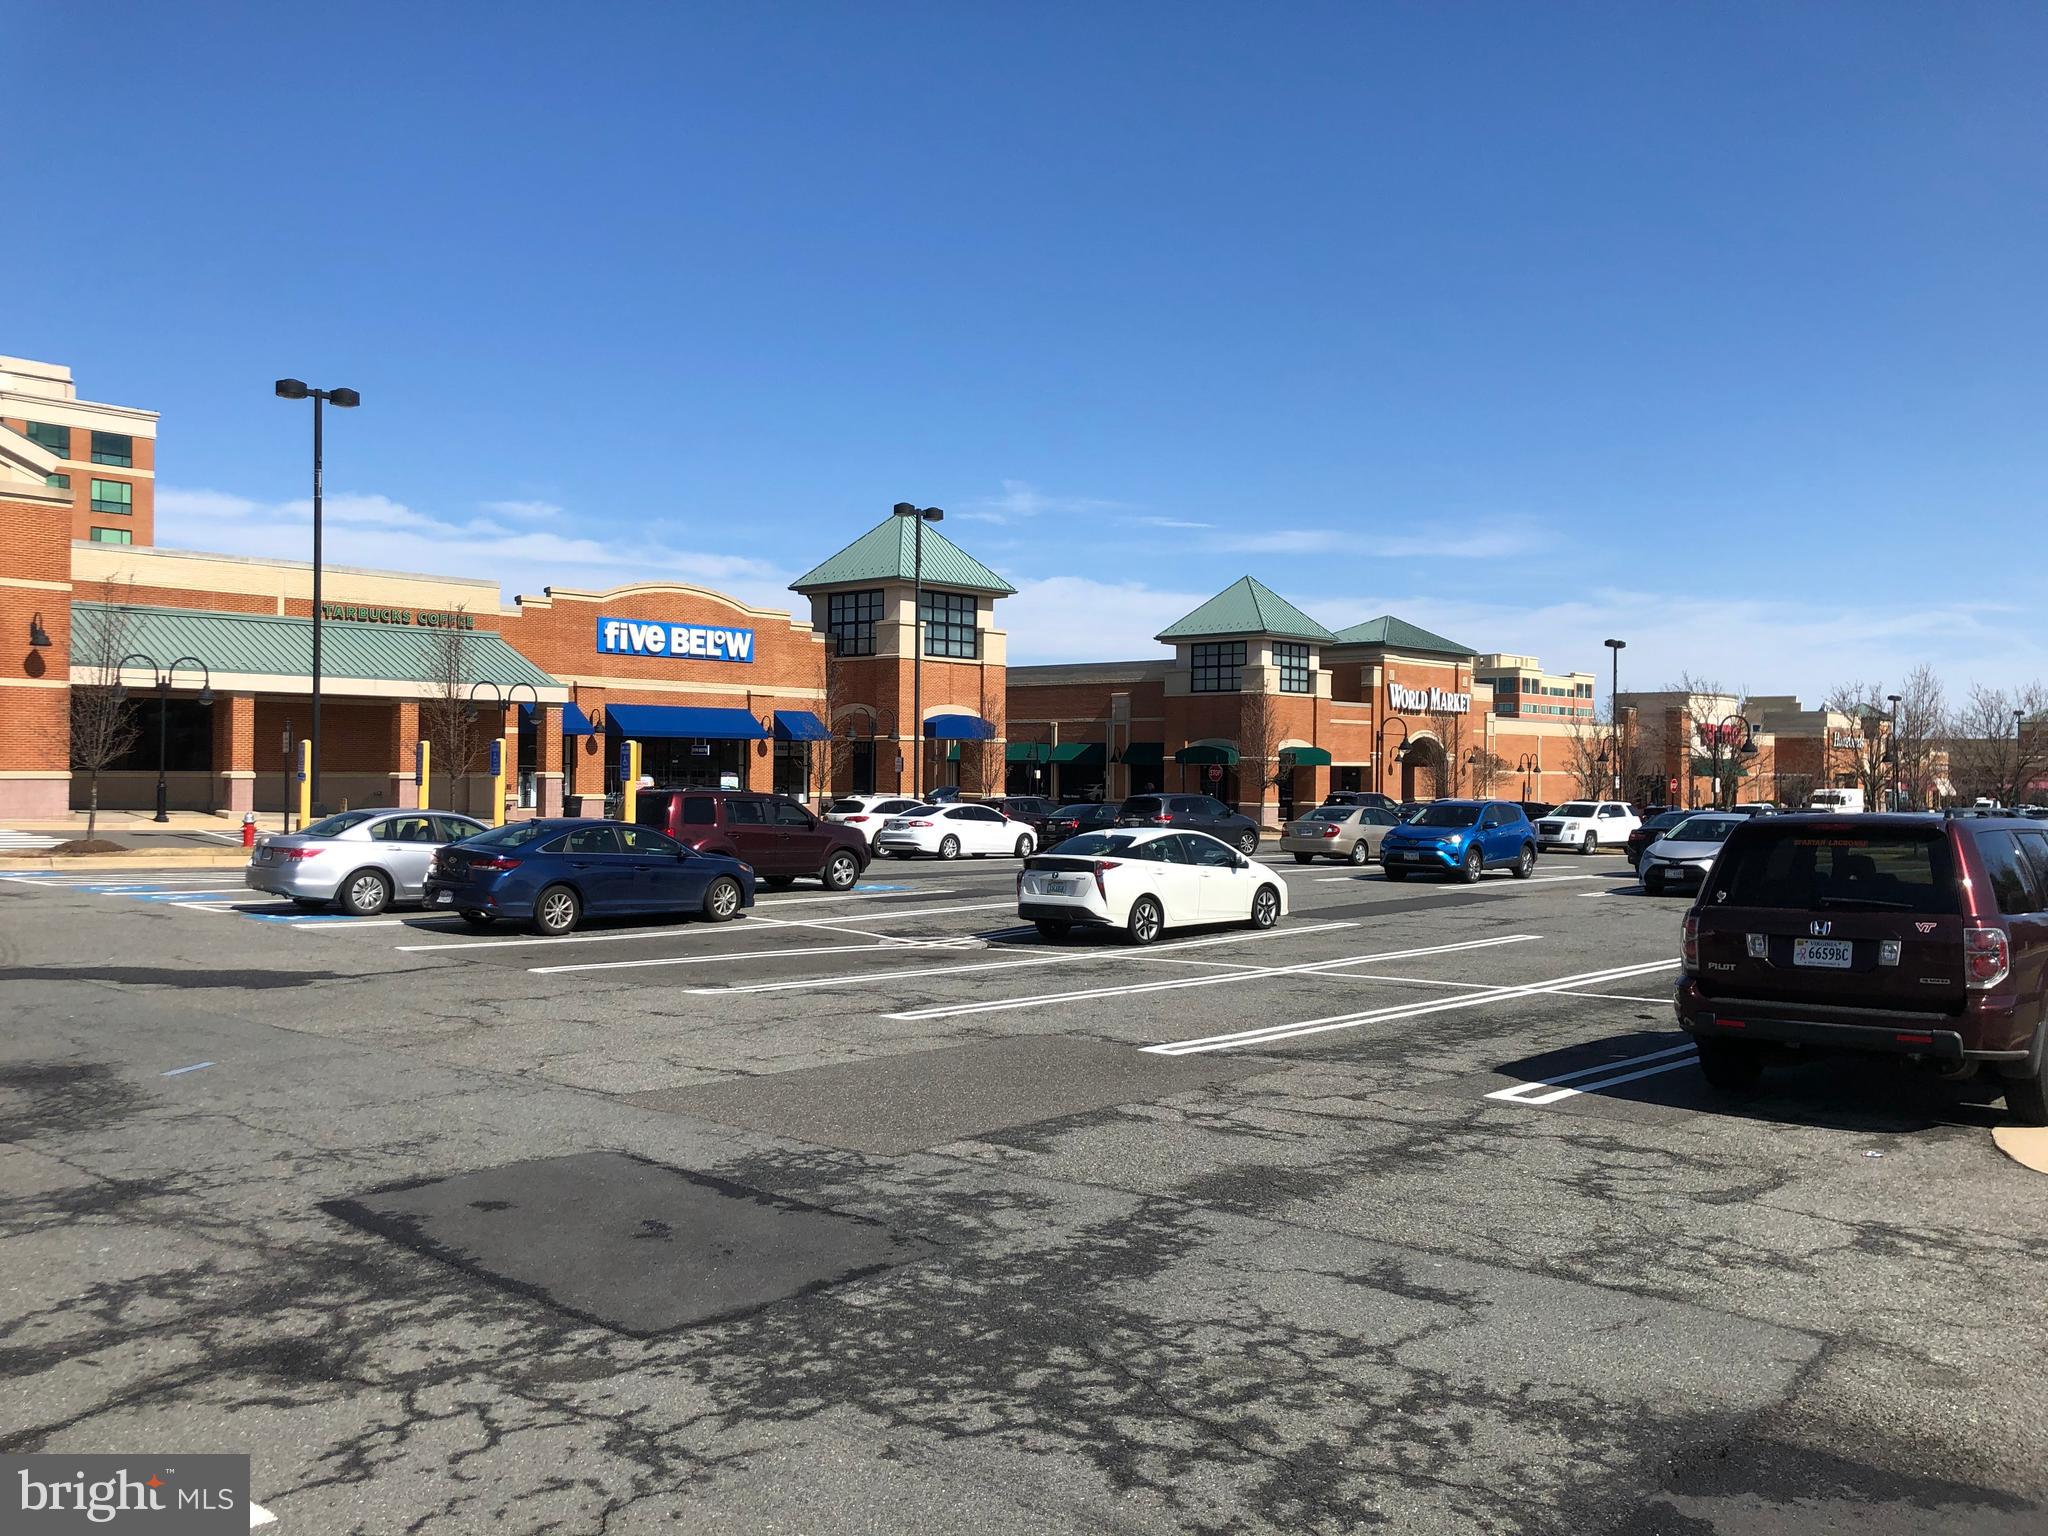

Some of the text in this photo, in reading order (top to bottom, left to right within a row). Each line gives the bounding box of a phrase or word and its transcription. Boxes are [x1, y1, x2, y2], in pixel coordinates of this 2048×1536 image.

[320, 604, 412, 624] TARBUCKS
[604, 621, 752, 659] five BELOW
[1390, 683, 1472, 712] WORLD MARKET
[1828, 839, 1869, 847] LACRO
[1914, 922, 1938, 933] VT
[1809, 940, 1838, 948] VIRGINIA
[1808, 947, 1849, 961] 6659BC
[1707, 962, 1737, 971] PILOT
